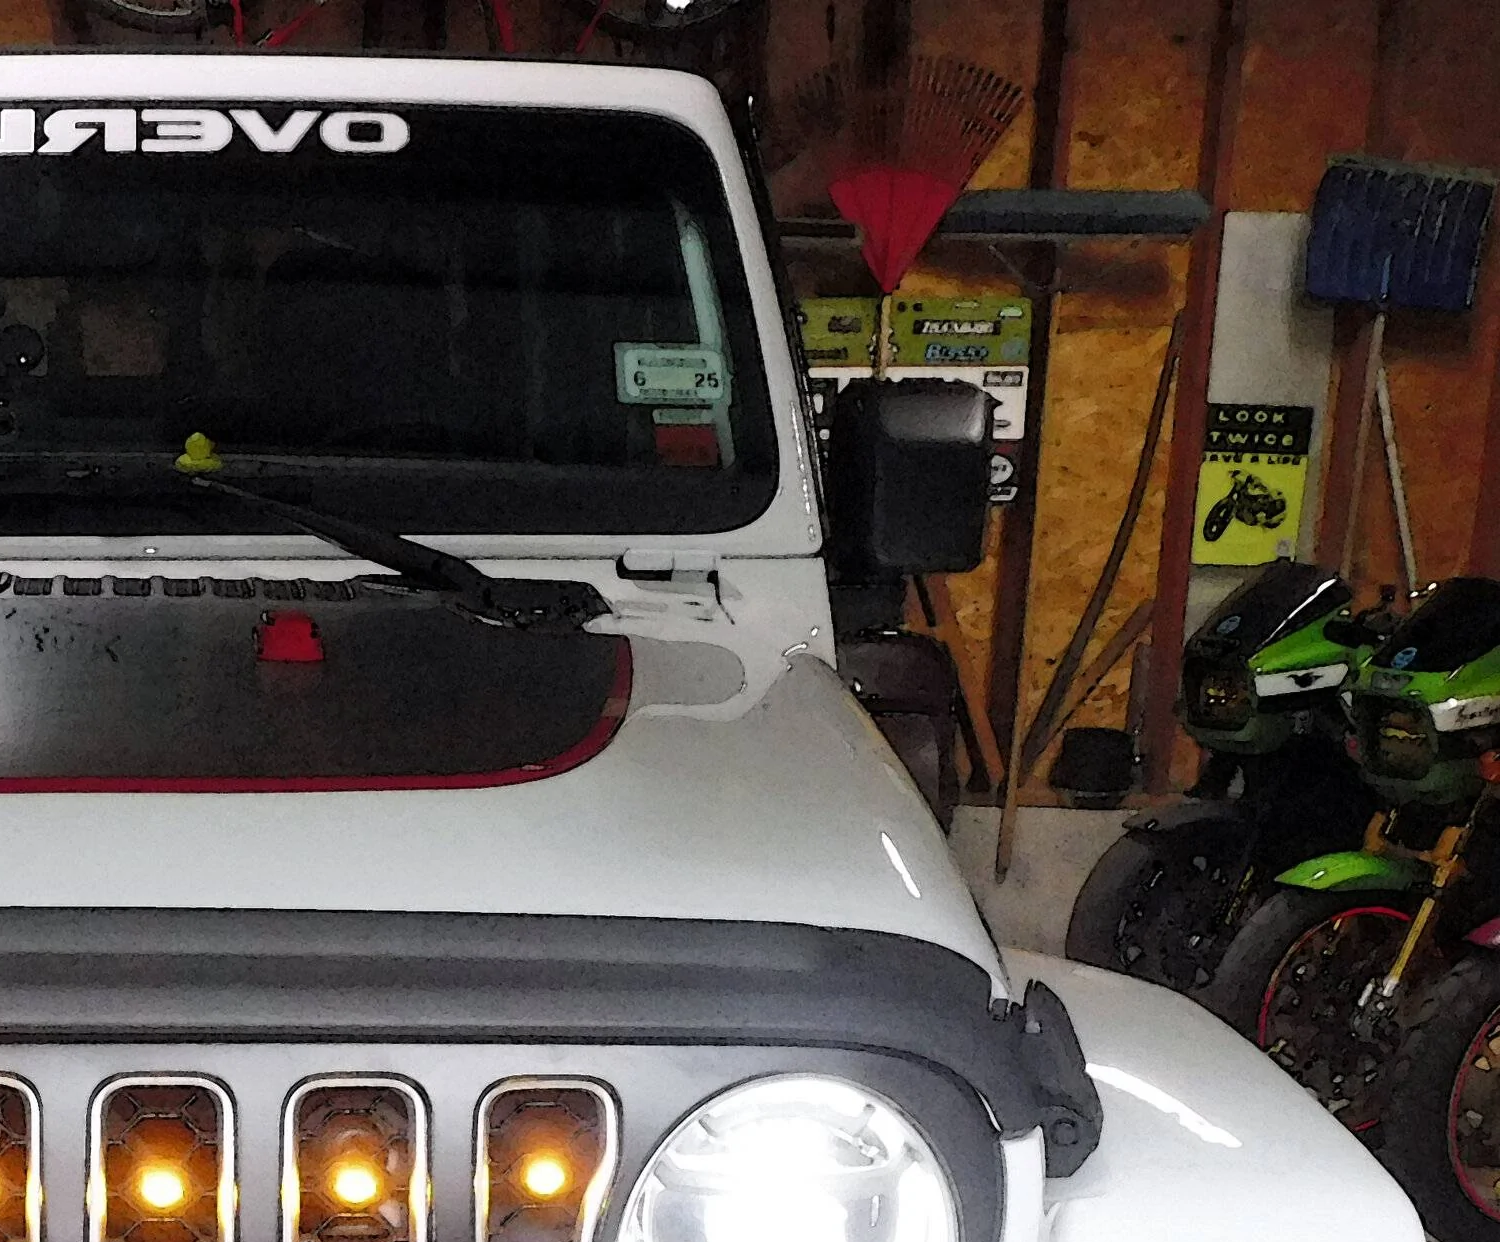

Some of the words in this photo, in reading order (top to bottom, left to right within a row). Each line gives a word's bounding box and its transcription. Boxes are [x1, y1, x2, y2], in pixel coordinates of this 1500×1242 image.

[633, 371, 646, 387] 6
[694, 372, 719, 388] 25
[1218, 410, 1285, 424] LOOK
